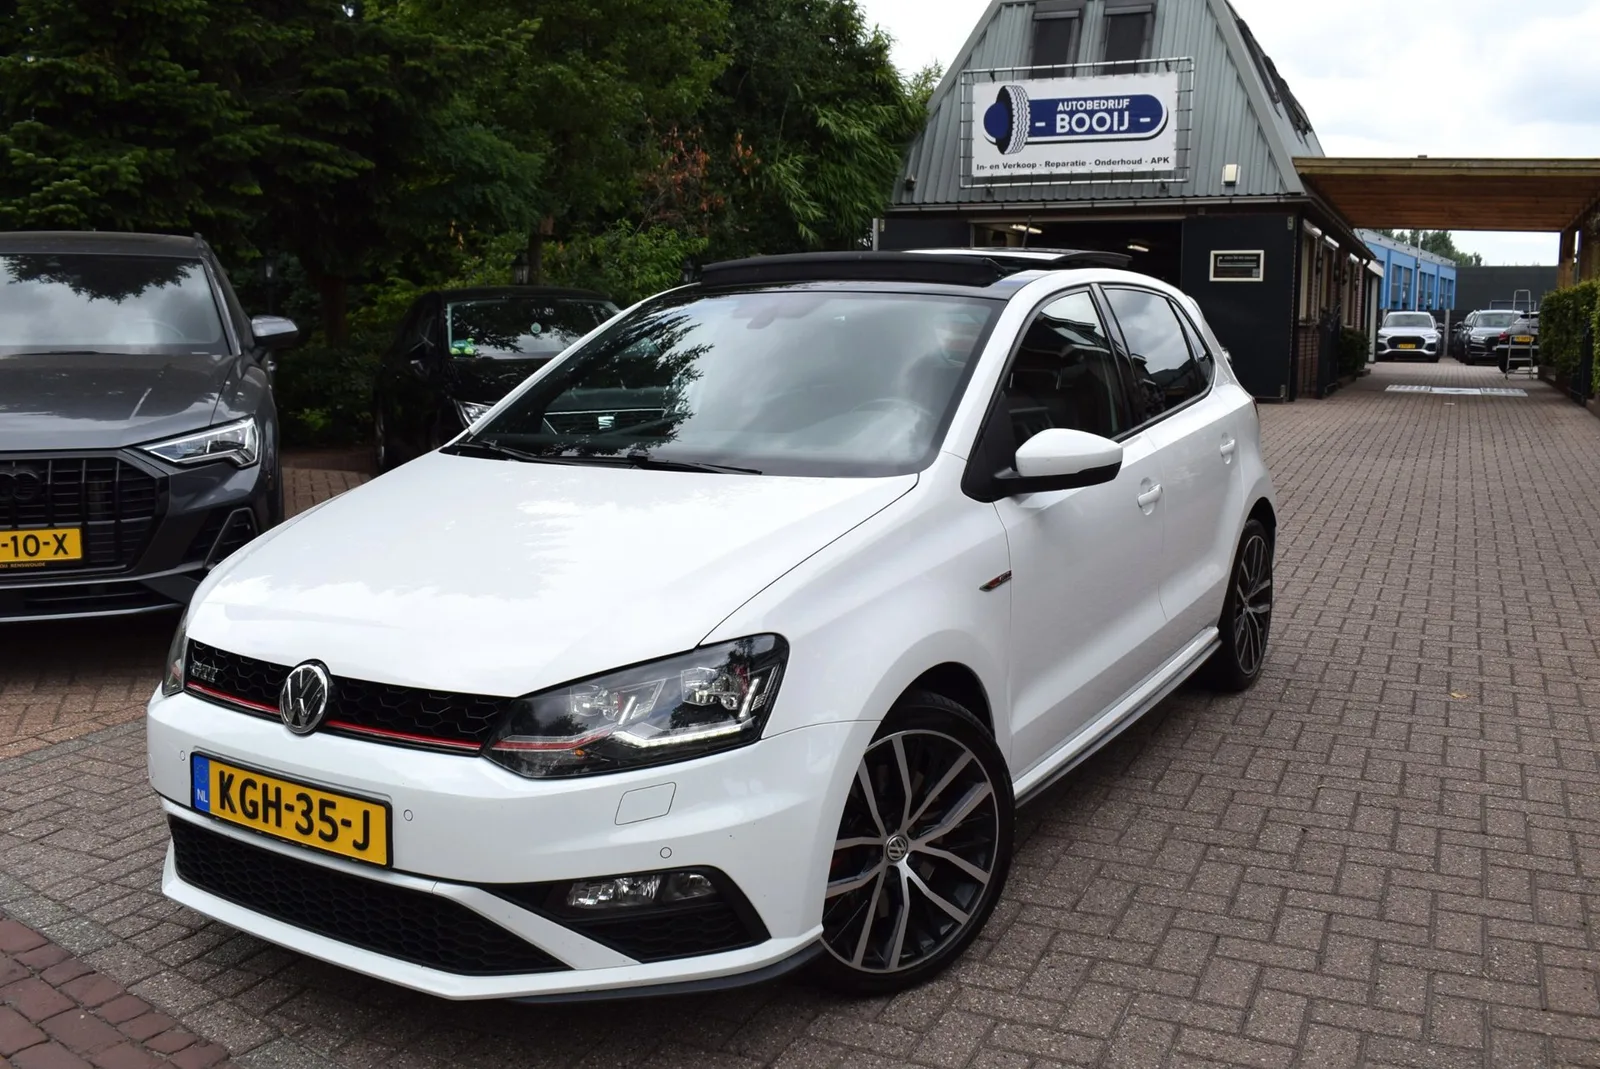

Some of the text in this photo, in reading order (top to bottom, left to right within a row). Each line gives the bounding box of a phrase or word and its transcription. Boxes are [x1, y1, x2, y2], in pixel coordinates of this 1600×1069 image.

[1057, 98, 1130, 112] AUTOBEDRIJF
[1056, 111, 1129, 134] BOOIJ
[1044, 159, 1087, 168] Reparatie
[1094, 158, 1143, 166] Onderhoud
[1150, 156, 1170, 164] APK
[196, 788, 209, 803] NL
[218, 769, 371, 851] KGH-35-J
